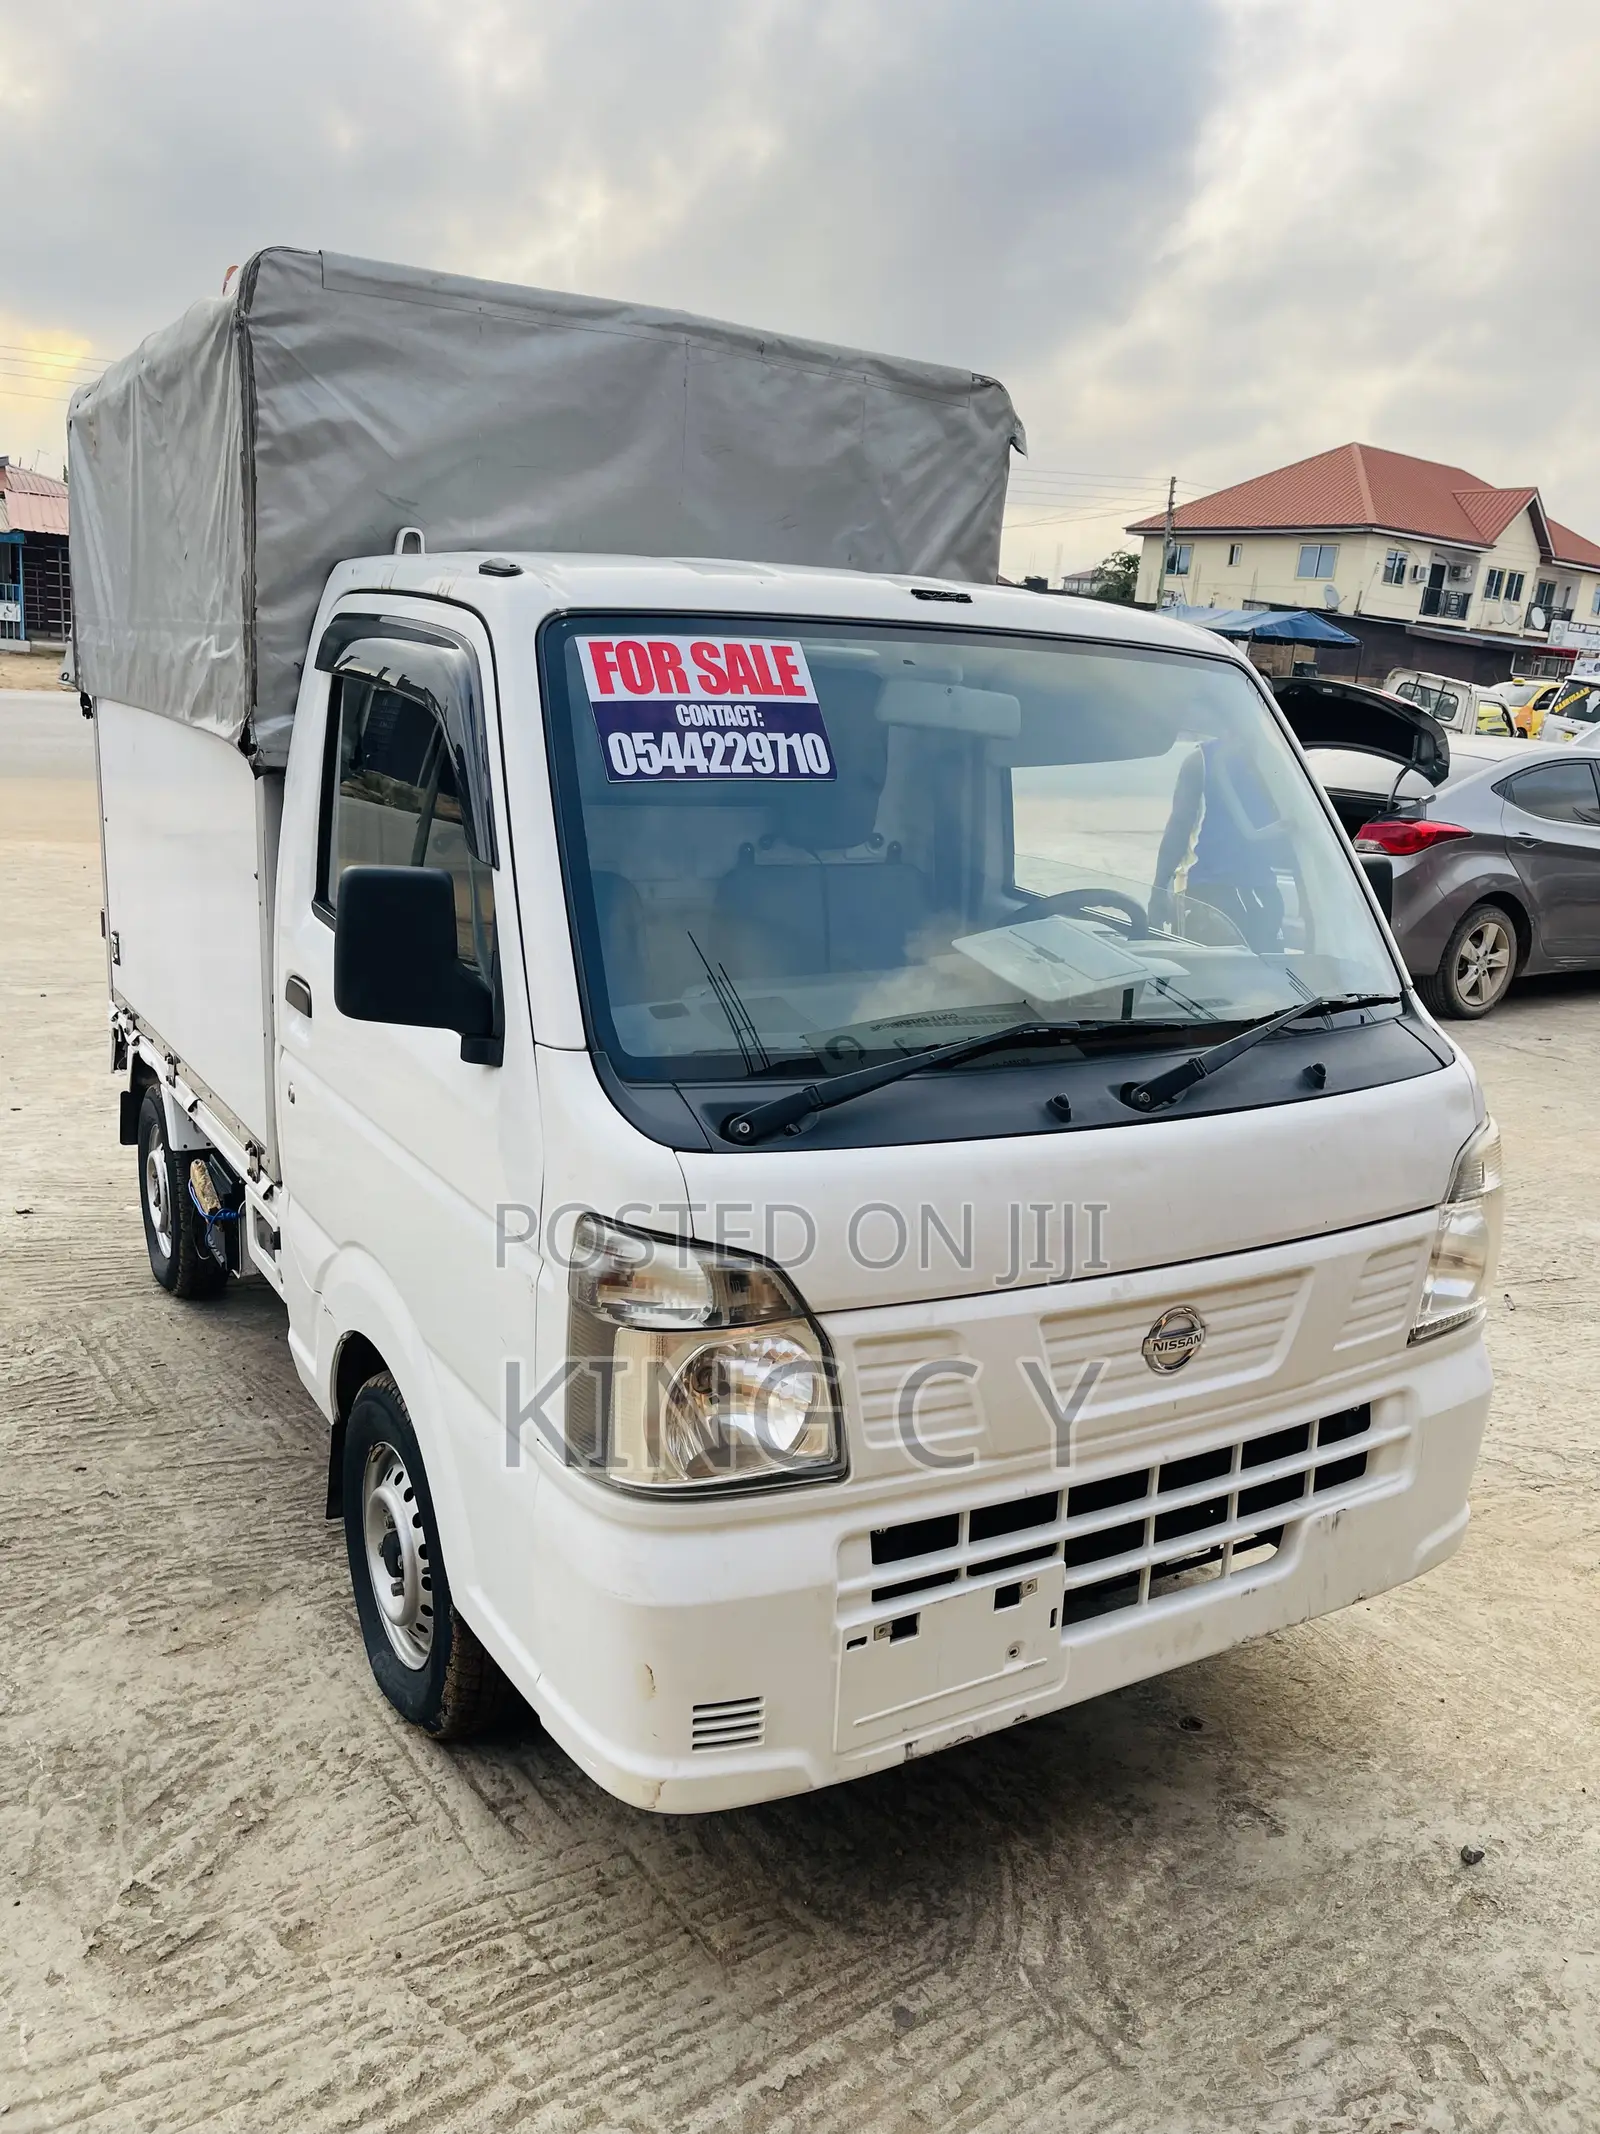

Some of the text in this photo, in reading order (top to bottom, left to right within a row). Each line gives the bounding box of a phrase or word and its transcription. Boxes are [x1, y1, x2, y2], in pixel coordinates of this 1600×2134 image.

[588, 640, 807, 697] FOR SALE
[675, 703, 765, 727] CONTACT:
[607, 731, 831, 776] 0544229710
[1152, 1333, 1203, 1352] NISSAN
